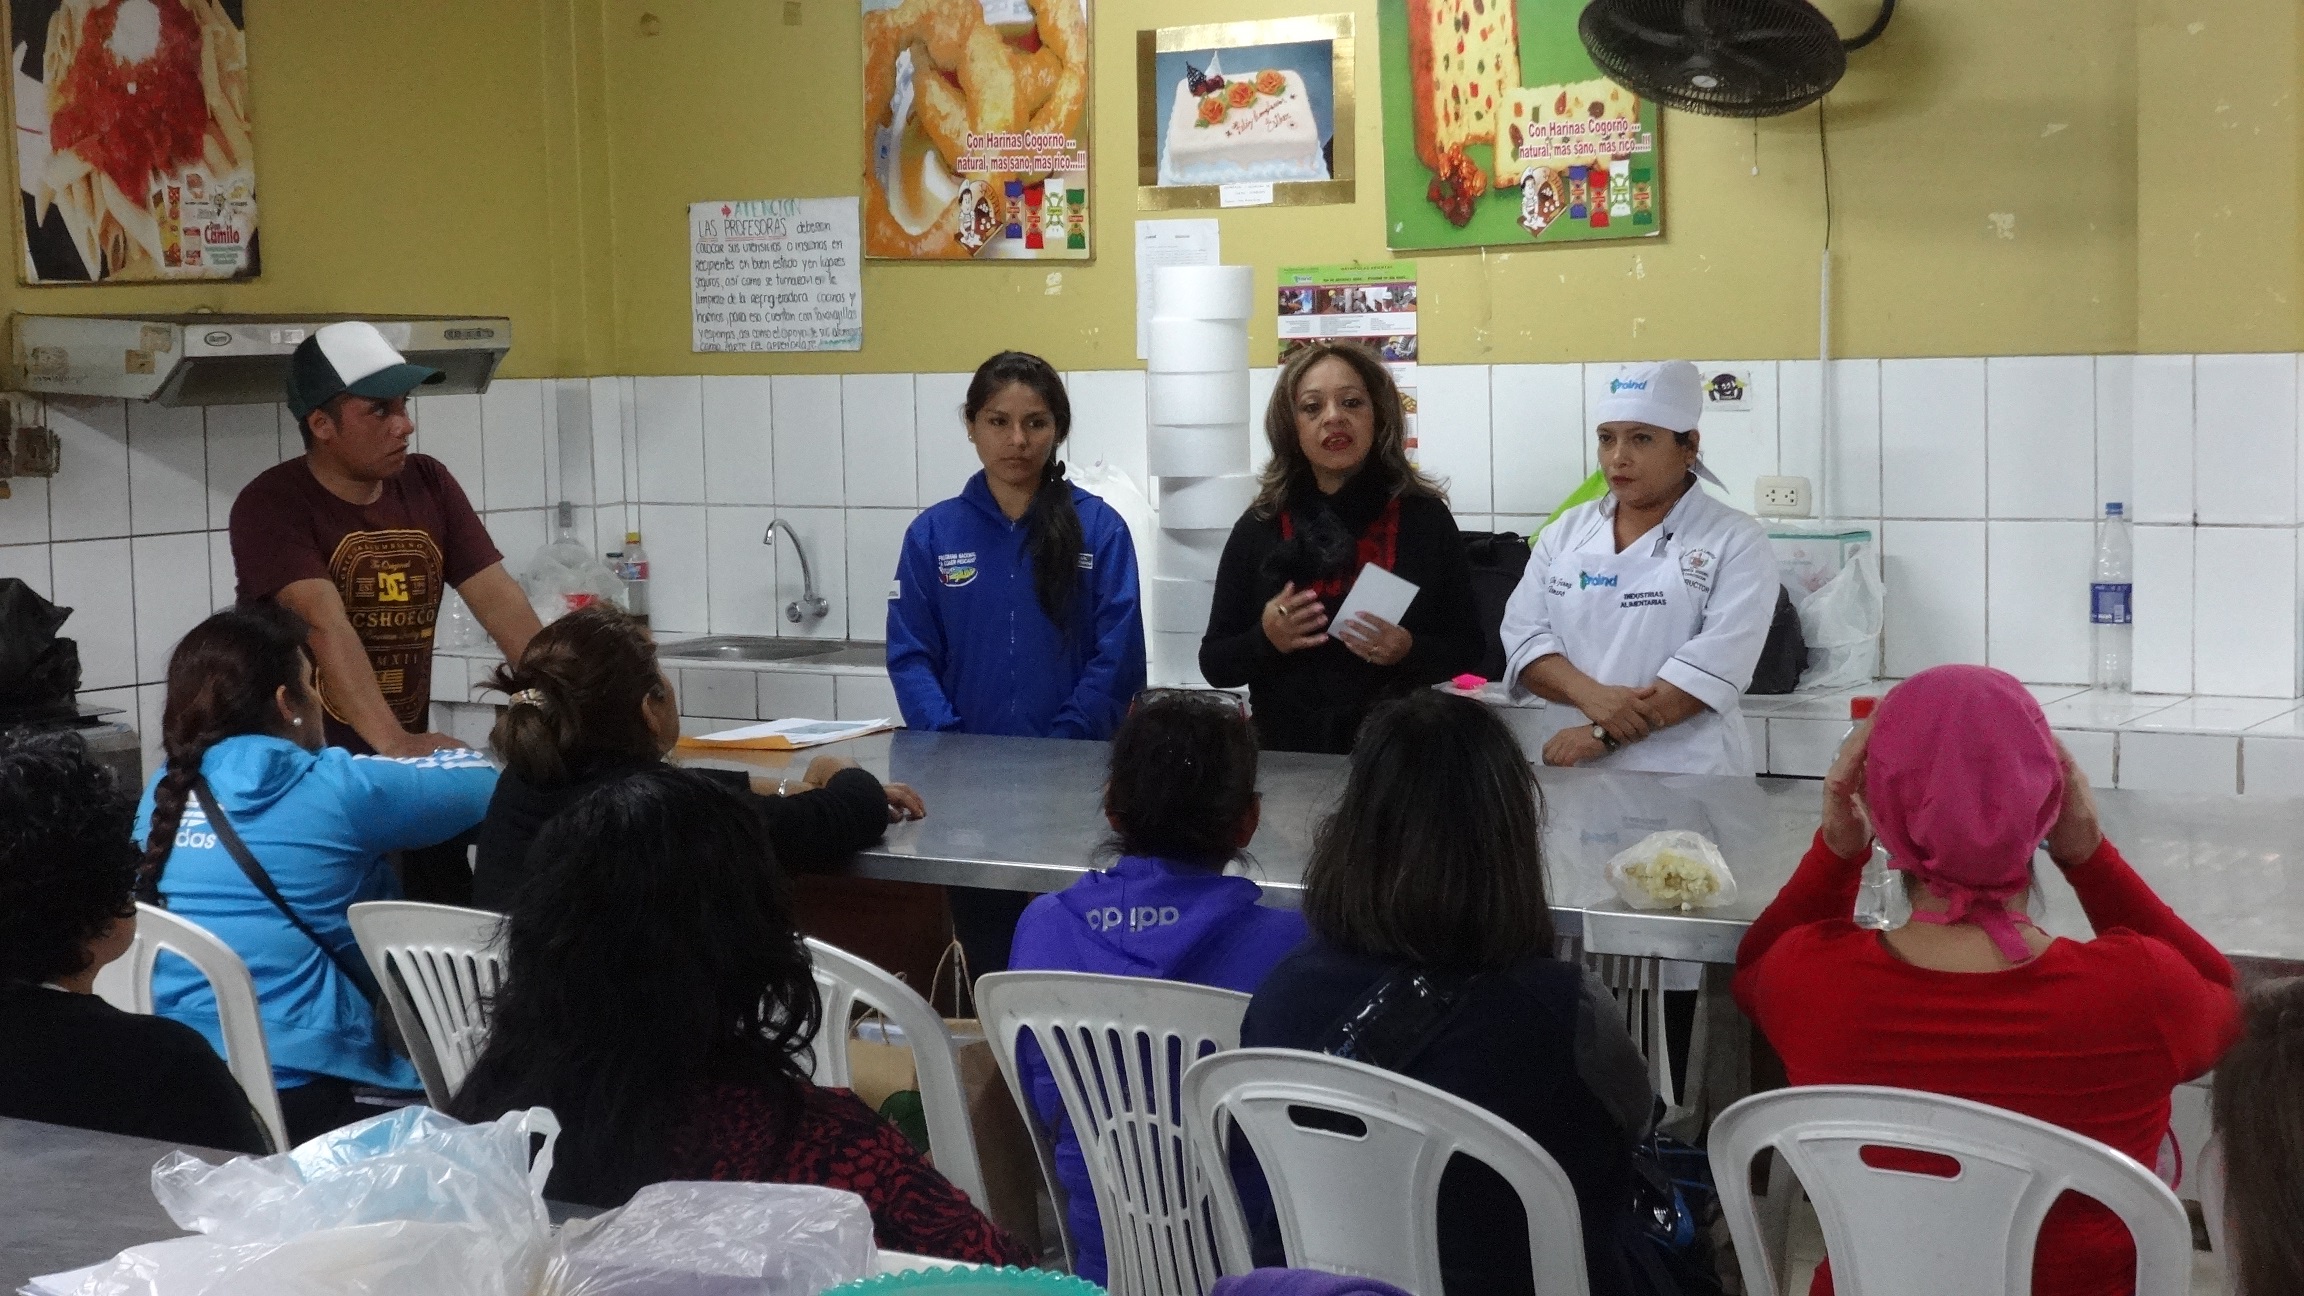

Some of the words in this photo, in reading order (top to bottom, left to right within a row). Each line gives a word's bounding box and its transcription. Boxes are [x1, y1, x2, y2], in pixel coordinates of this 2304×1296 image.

[1528, 123, 1546, 137] Con
[1549, 121, 1585, 136] Harinas
[1588, 119, 1628, 136] Cogorno
[966, 133, 984, 149] Con
[986, 132, 1022, 148] Harinas
[1024, 131, 1065, 151] Cogorno
[1519, 144, 1552, 159] natural,
[1554, 146, 1571, 156] mas
[1599, 141, 1616, 153] mas
[957, 154, 989, 172] natural,
[991, 158, 1008, 171] mas
[1010, 157, 1033, 173] sano,
[1034, 156, 1052, 170] mas
[204, 224, 240, 244] Camilo
[698, 219, 718, 238] LAS
[723, 217, 787, 237] PROFESORAS
[1623, 590, 1664, 600] INDUSTRIAS
[1683, 578, 1711, 594] RUCTOR
[1620, 598, 1667, 609] ALIMENTARIAS
[352, 608, 435, 628] CSHOECO
[174, 828, 217, 850] das
